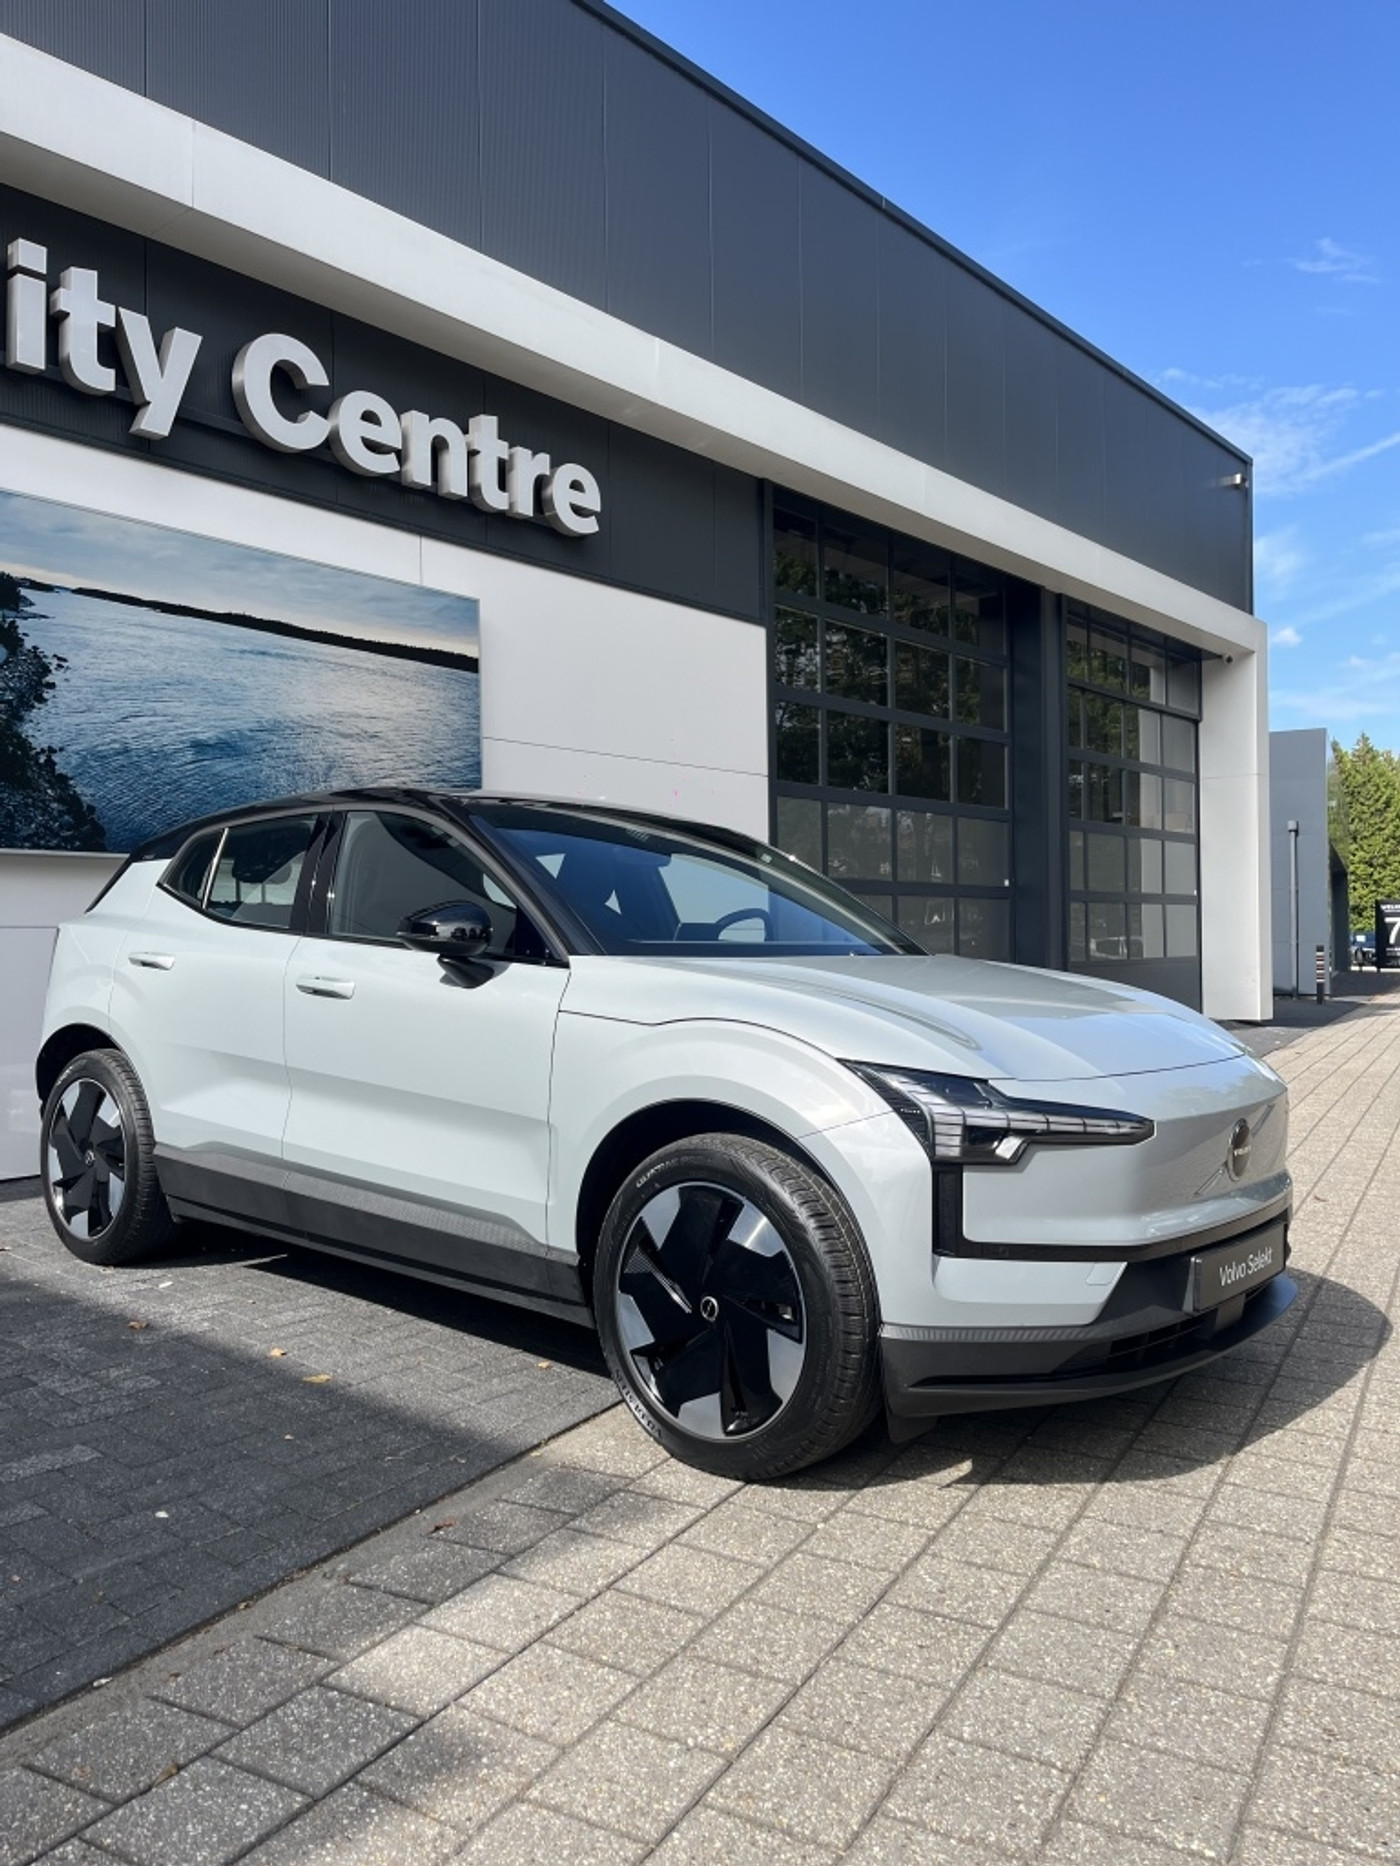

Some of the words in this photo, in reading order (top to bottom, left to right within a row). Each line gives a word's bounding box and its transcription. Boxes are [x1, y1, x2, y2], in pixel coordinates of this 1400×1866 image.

[6, 237, 203, 440] ity
[232, 332, 601, 537] Centre
[1219, 1261, 1247, 1287] Volvo
[1247, 1246, 1273, 1275] Selekt
